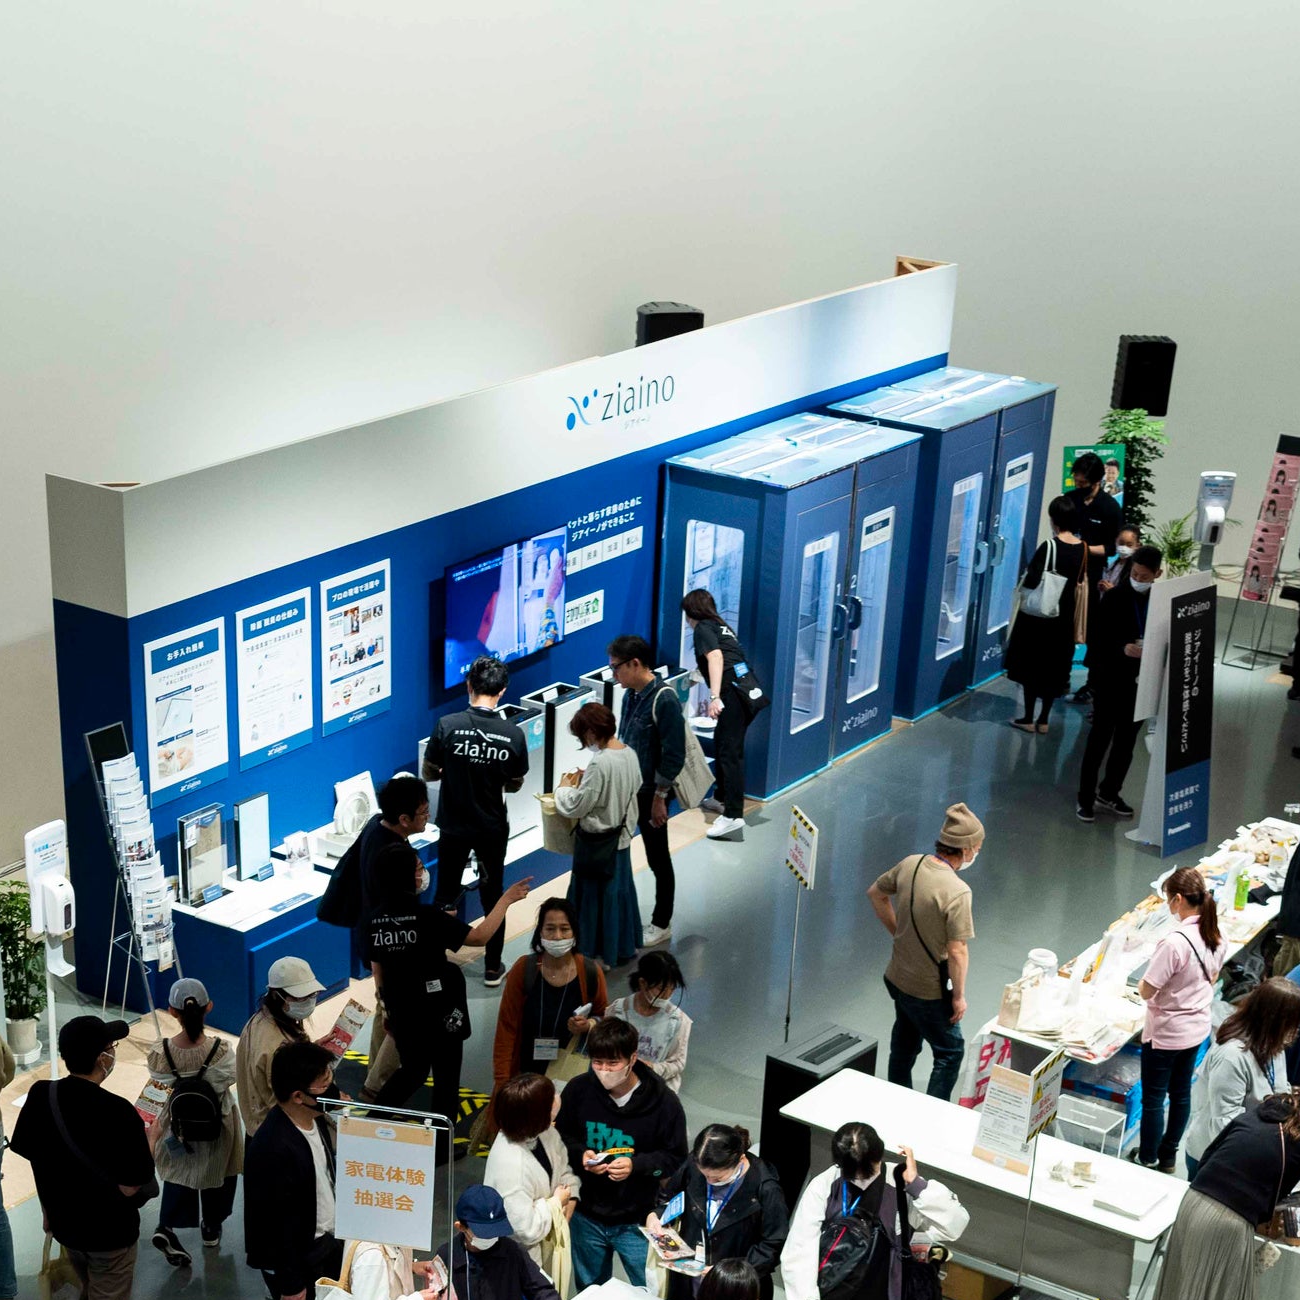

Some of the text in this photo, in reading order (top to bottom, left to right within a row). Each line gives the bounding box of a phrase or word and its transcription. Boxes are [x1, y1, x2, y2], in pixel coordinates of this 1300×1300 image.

[602, 375, 675, 421] ziaino
[850, 574, 858, 589] 2
[453, 739, 509, 761] ziaino
[371, 928, 417, 946] ziaino
[344, 1160, 426, 1187] 家電体験
[353, 1188, 415, 1213] 抽選会
